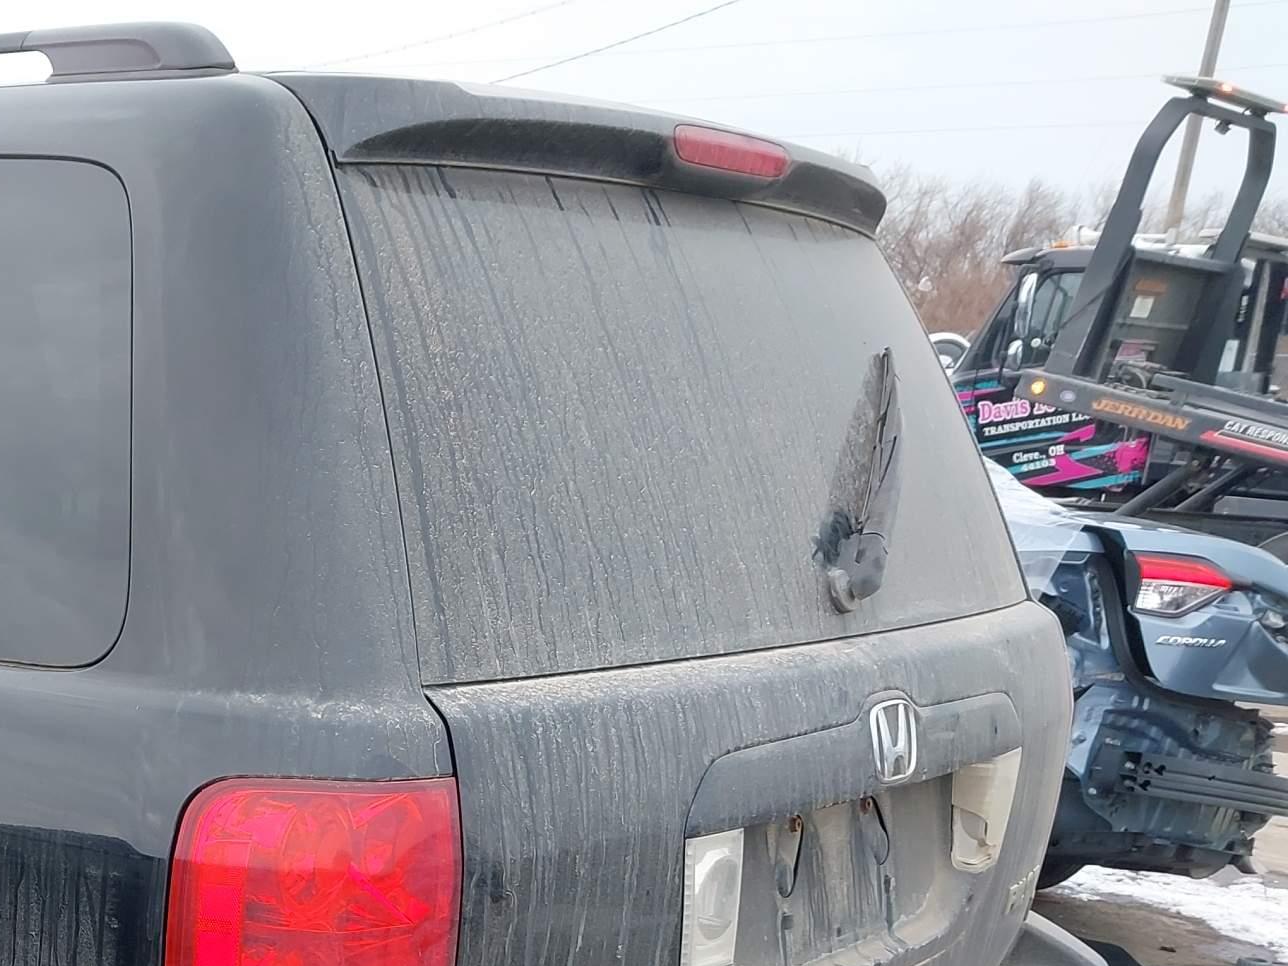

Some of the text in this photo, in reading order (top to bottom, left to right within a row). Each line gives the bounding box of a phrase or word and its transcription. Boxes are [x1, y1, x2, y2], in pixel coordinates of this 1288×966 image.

[978, 399, 1030, 424] Davis
[983, 414, 1070, 436] TRANSPORTATION
[1048, 444, 1065, 456] OH
